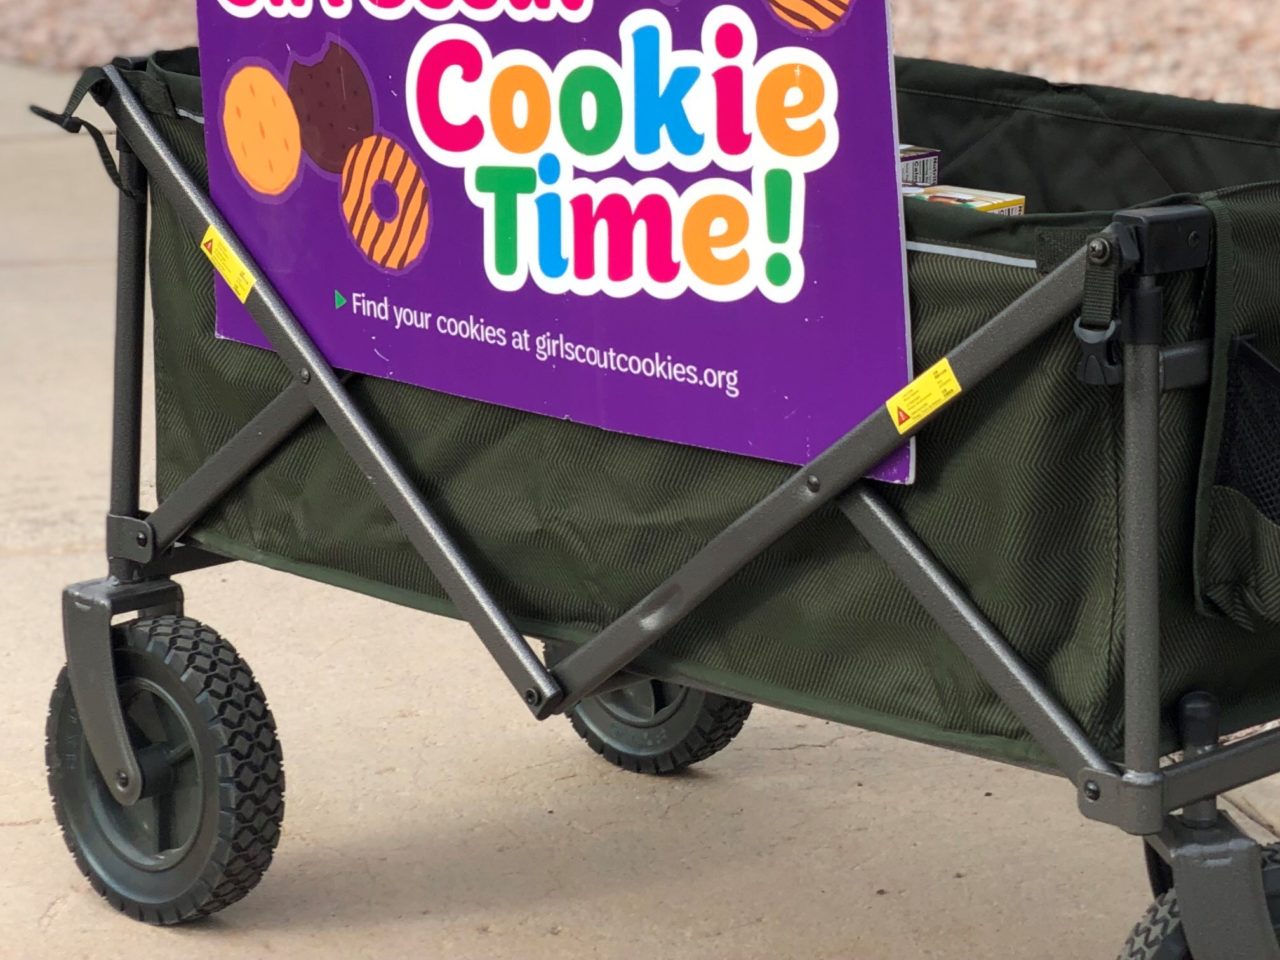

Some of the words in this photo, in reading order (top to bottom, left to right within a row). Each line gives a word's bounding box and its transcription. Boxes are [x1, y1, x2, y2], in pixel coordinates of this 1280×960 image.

[415, 22, 827, 158] Cookie
[474, 152, 793, 287] Time!
[351, 292, 389, 321] Find
[392, 304, 432, 330] your
[436, 314, 507, 347] cookies
[511, 328, 531, 352] at
[535, 331, 740, 398] girlscoutcookies.org
